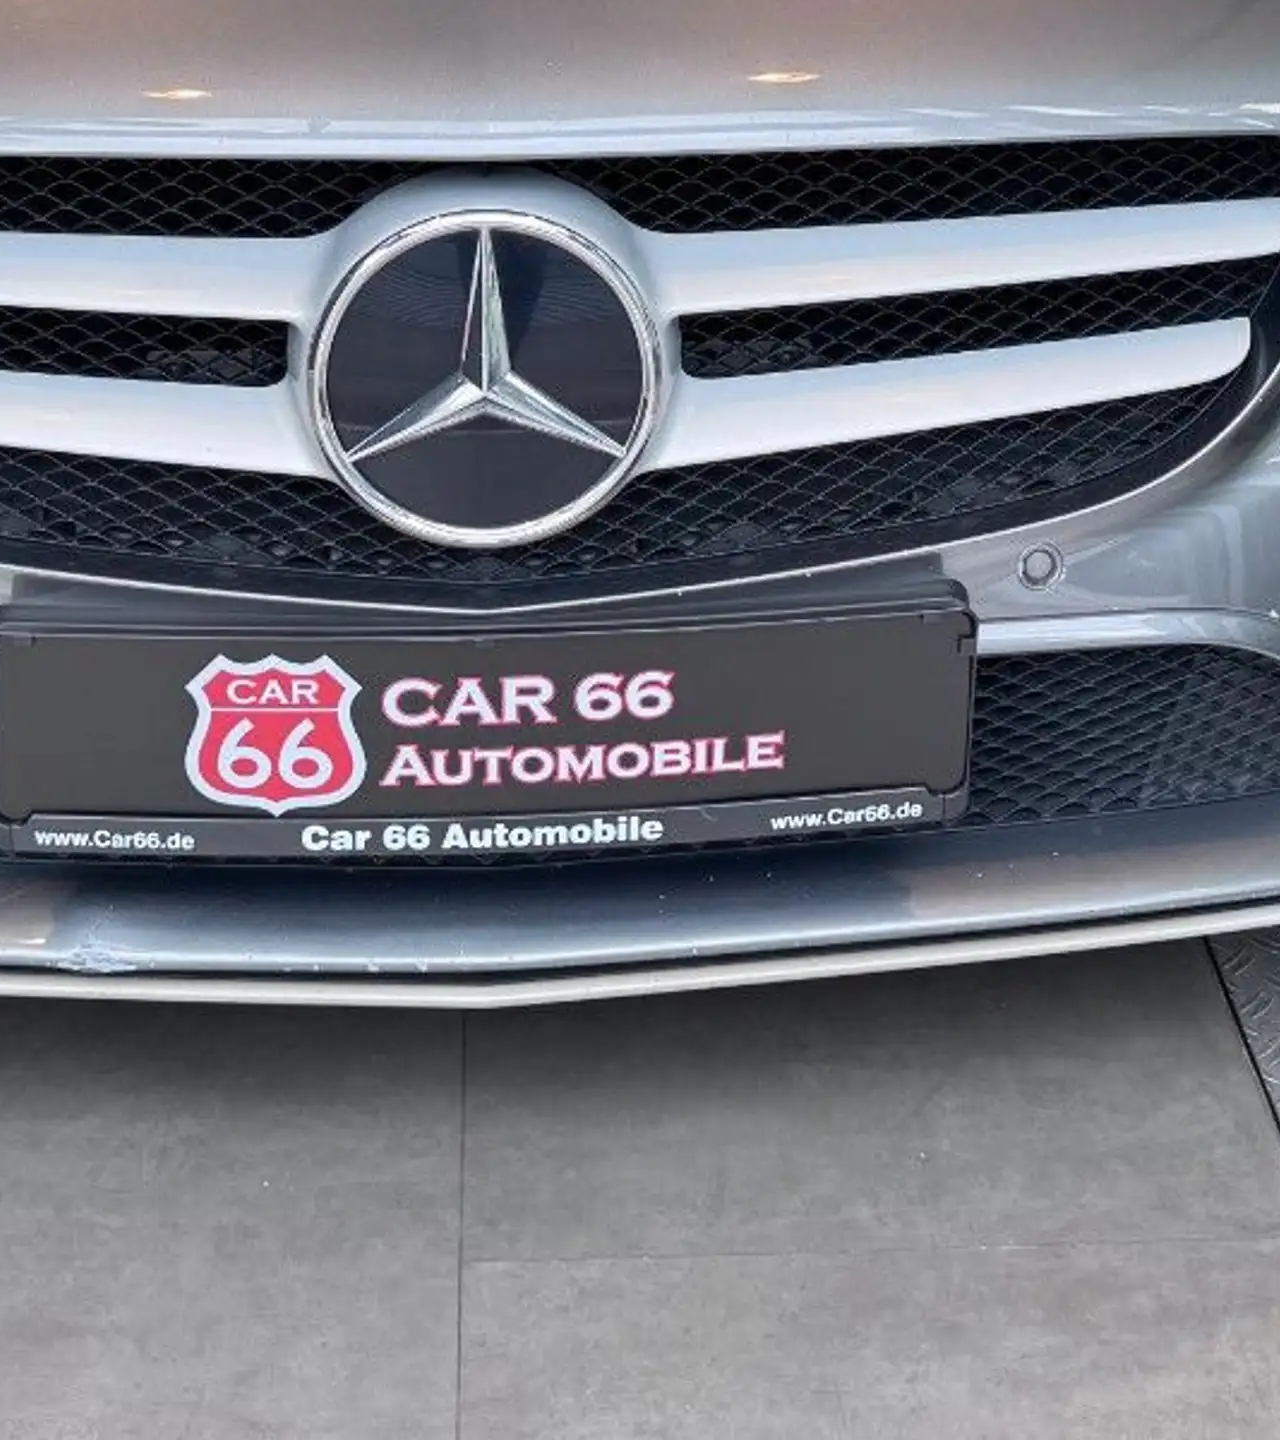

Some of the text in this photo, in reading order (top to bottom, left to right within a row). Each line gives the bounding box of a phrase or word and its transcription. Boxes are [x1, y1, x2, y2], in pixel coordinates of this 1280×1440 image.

[227, 678, 319, 706] CAR
[381, 669, 676, 727] CAR 66
[217, 717, 334, 790] 66
[378, 730, 787, 787] AUTOMOBILE
[301, 815, 664, 851] Car 66 Automobile
[770, 801, 923, 831] www.Car66.de
[34, 828, 196, 850] www.Car66.de
